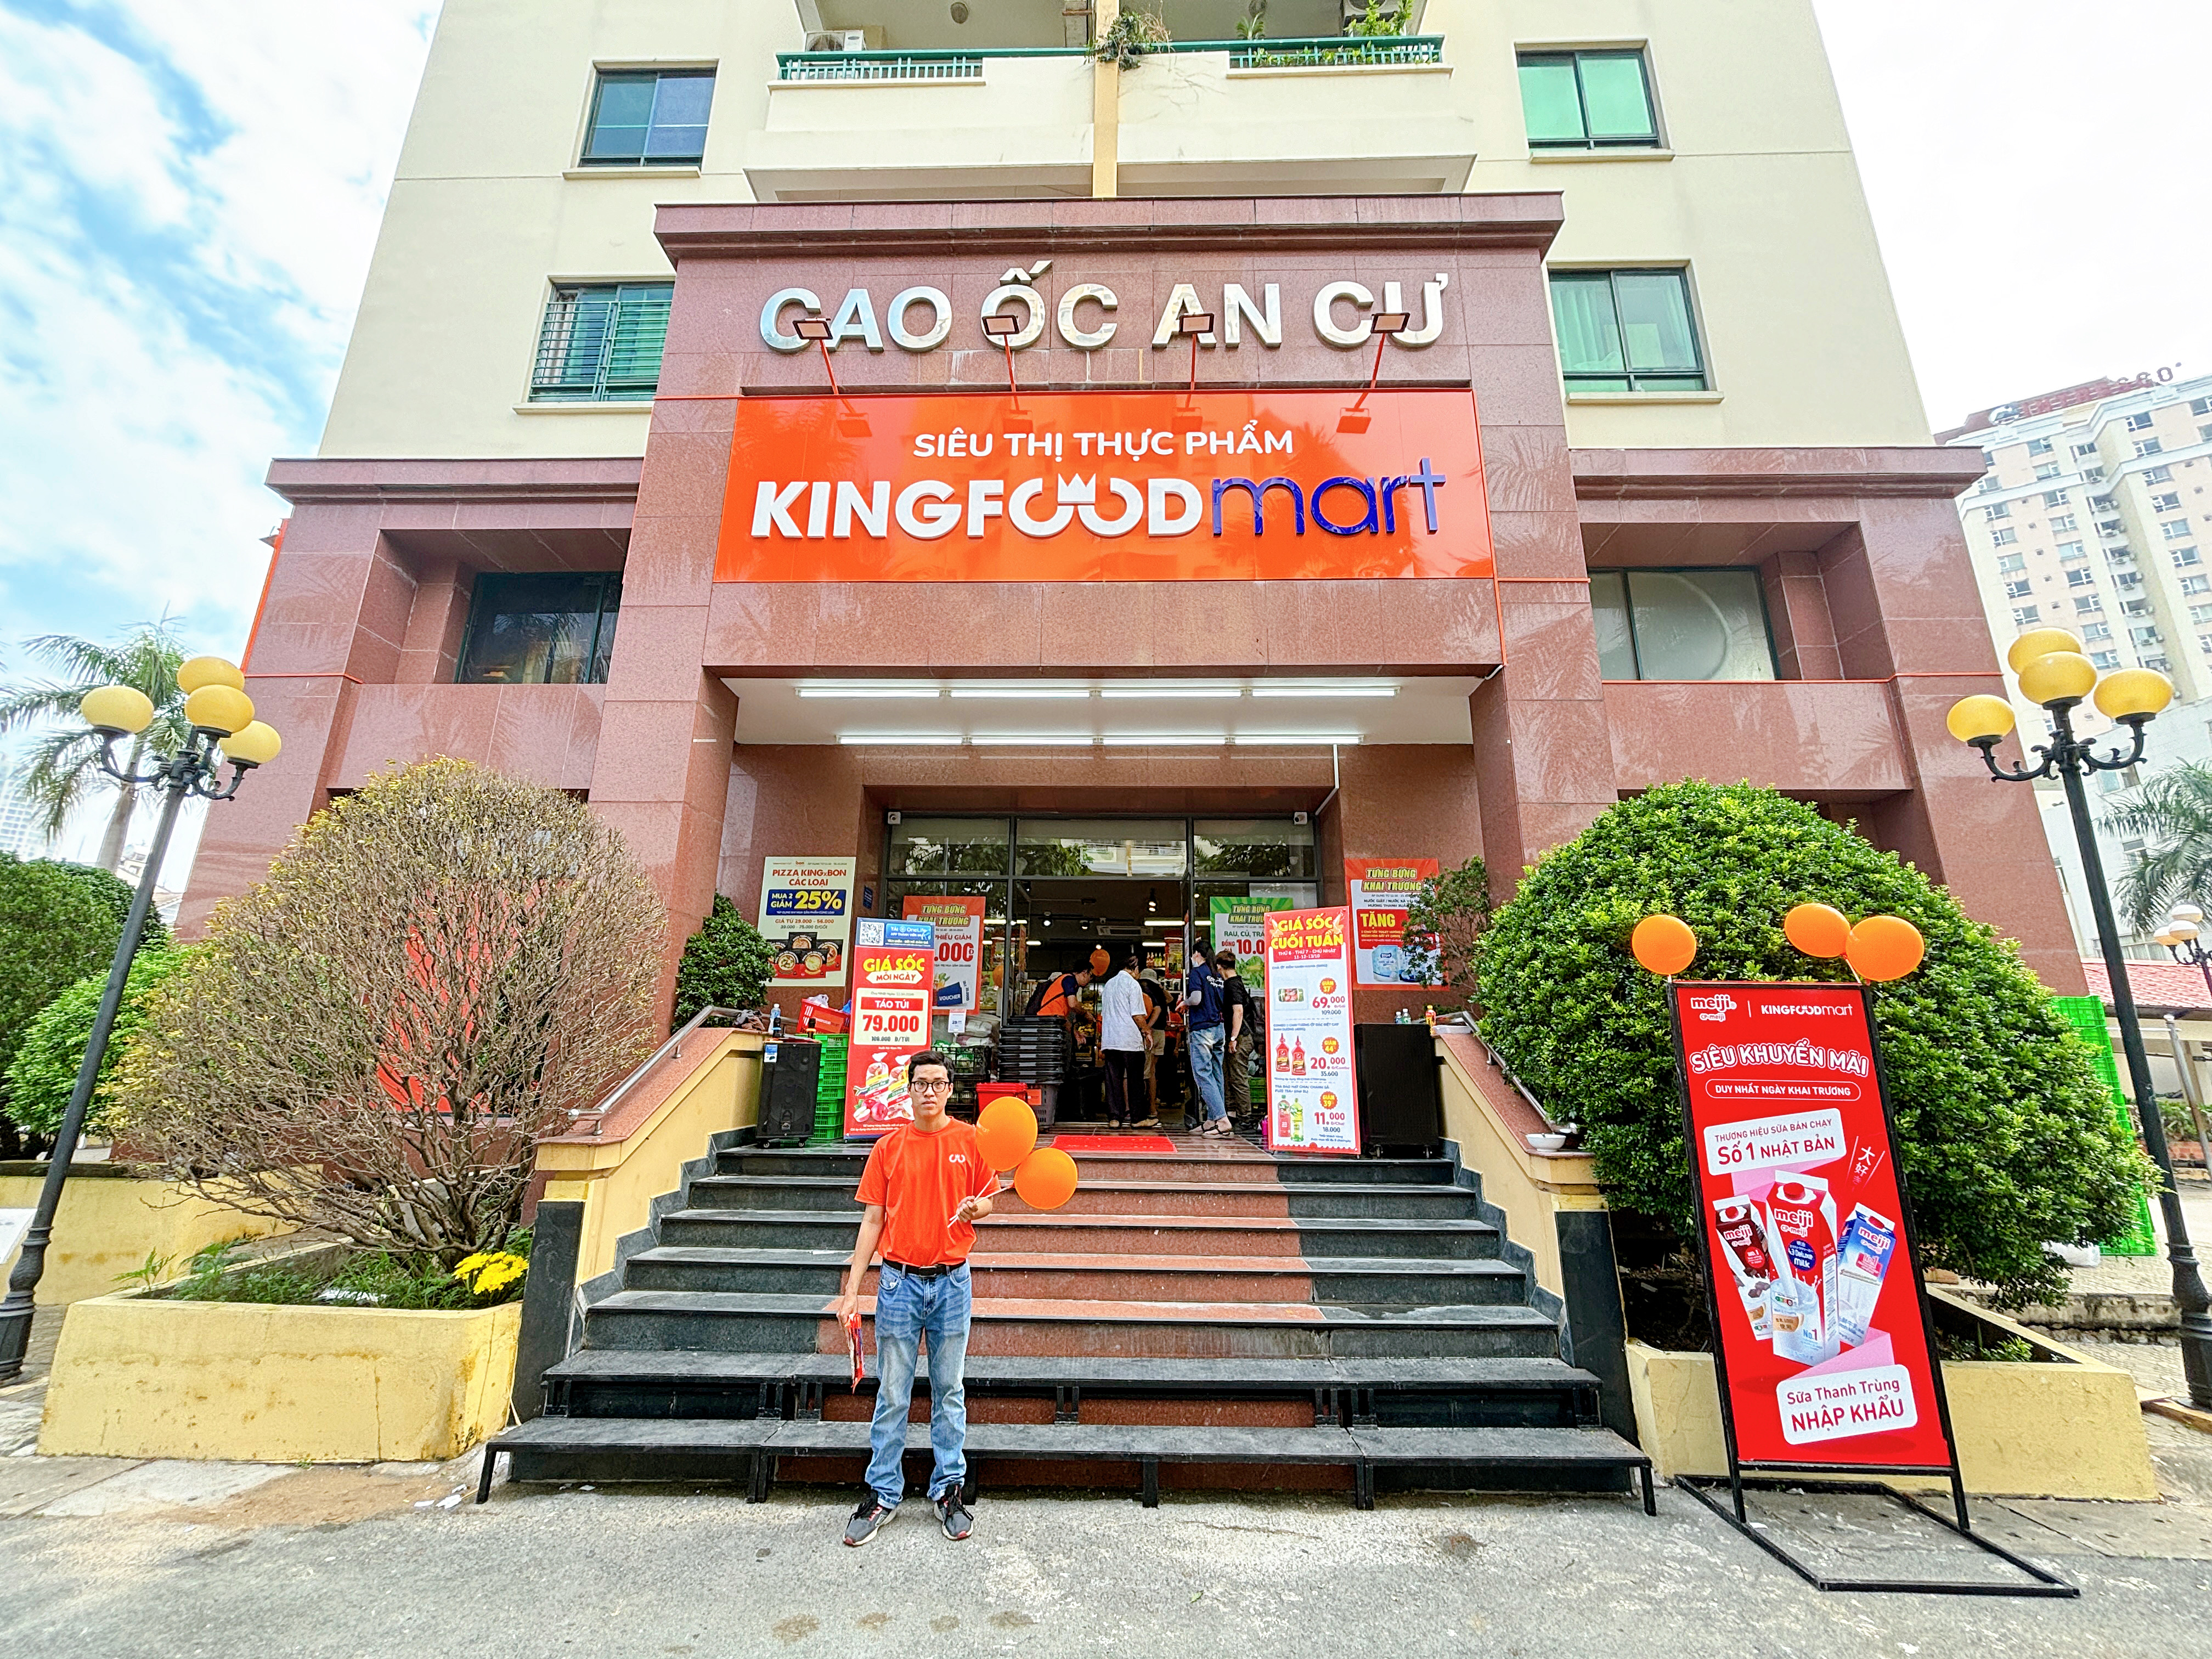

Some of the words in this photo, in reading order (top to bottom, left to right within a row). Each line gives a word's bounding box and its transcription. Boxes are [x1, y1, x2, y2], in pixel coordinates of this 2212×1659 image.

[761, 286, 952, 354] CAO
[980, 261, 1118, 351] ỐC
[1152, 283, 1283, 350] AN
[1313, 272, 1448, 349] CƯ
[913, 428, 992, 458] SIÊU
[1004, 432, 1064, 462] THỊ
[1073, 428, 1174, 462] THỰC
[1186, 419, 1294, 455] PHẨM
[752, 457, 1446, 538] KINGFOODmart
[789, 877, 806, 886] CÁC
[808, 878, 828, 888] LOẠI
[1363, 881, 1385, 891] KHAI
[794, 890, 843, 910] 25%
[1229, 915, 1247, 923] KHAI
[1278, 916, 1304, 932] GIÁ
[1306, 912, 1333, 930] SỐC
[1360, 911, 1396, 929] TẶNG
[1237, 939, 1265, 955] 10.0
[1271, 932, 1303, 950] CUỐI
[1305, 929, 1344, 948] TUẦN
[863, 955, 893, 972] GIÁ
[895, 953, 926, 972] SỐC
[893, 972, 916, 981] NGÀY
[874, 998, 894, 1008] TÁO
[894, 998, 910, 1009] TÚI
[939, 994, 961, 1002] VOUCHER
[1760, 1003, 1853, 1016] KINGFOODmart
[862, 1014, 919, 1032] 79.000
[1690, 1045, 1735, 1073] SIÊU
[1740, 1039, 1825, 1066] KHUYẾN
[1829, 1051, 1868, 1076] MÃI
[1715, 1084, 1733, 1093] DUY
[1735, 1082, 1759, 1094] NHẤT
[1762, 1084, 1786, 1094] NGÀY
[1788, 1086, 1811, 1095] KHAI
[1813, 1086, 1851, 1096] TRƯƠNG
[1715, 1130, 1748, 1143] THƯƠNG
[1750, 1126, 1769, 1137] HIỆU
[1771, 1123, 1789, 1135] SỮA
[1809, 1118, 1833, 1129] CHẠY
[1718, 1140, 1742, 1165] Số
[1745, 1141, 1755, 1160] 1
[1760, 1139, 1800, 1159] NHẬT
[1804, 1133, 1835, 1153] BẢN
[1775, 1209, 1813, 1228] meiji
[1724, 1224, 1753, 1240] meiji
[1858, 1227, 1891, 1249] meiji
[1787, 1391, 1812, 1405] Sữa
[1815, 1383, 1857, 1401] Thanh
[1859, 1379, 1900, 1396] Trùng
[1791, 1404, 1845, 1432] NHẬP
[1849, 1394, 1904, 1424] KHẨU
